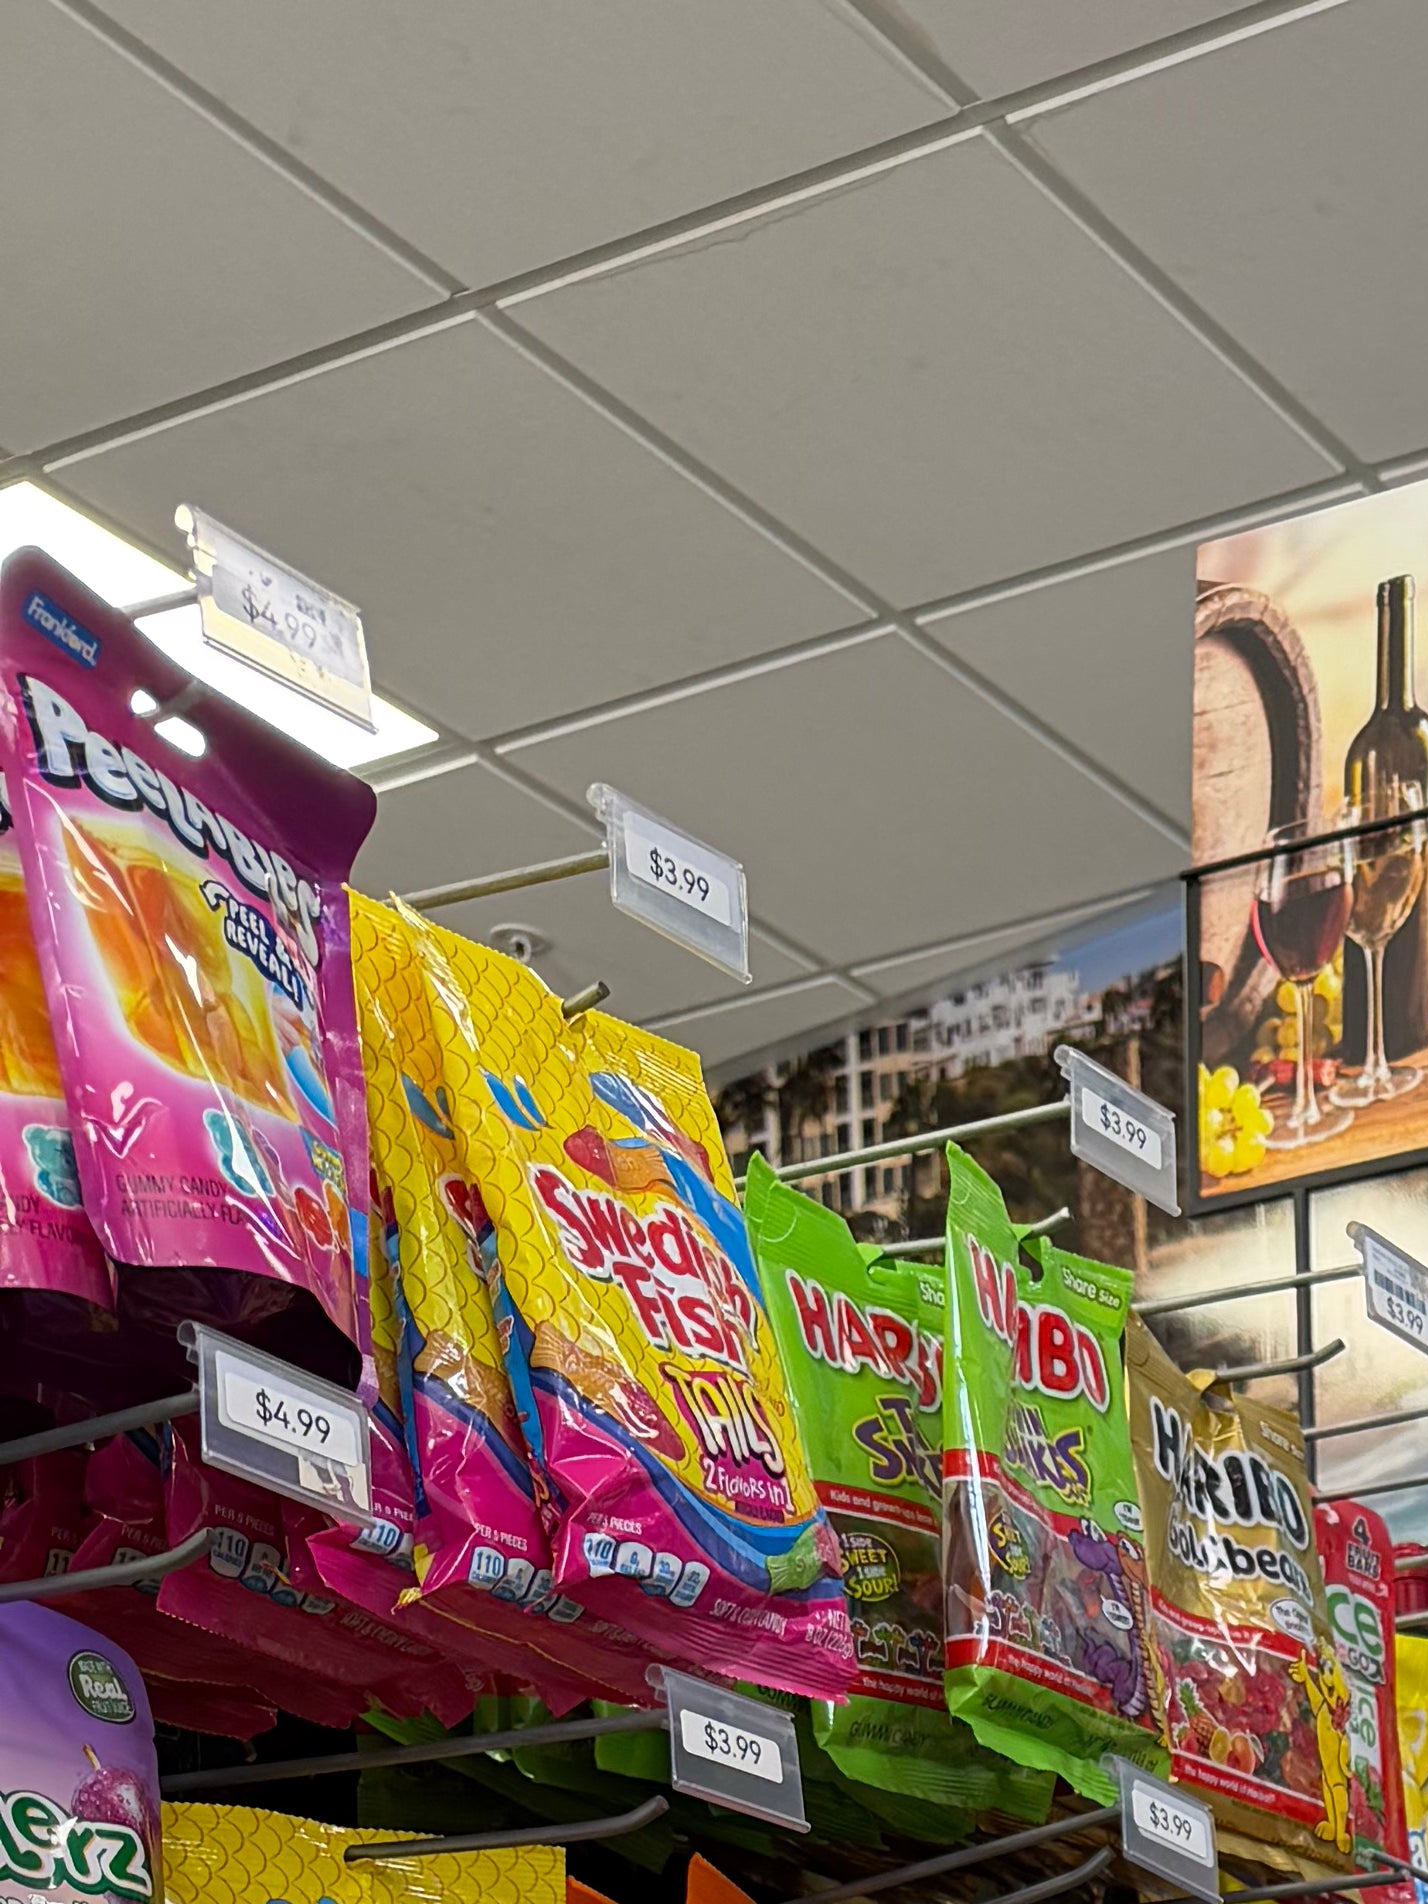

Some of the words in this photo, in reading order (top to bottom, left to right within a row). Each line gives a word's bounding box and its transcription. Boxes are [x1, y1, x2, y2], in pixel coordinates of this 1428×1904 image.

[241, 584, 319, 650] $4.99
[649, 847, 711, 901] $3.99
[228, 901, 273, 942] PEEL
[1100, 1105, 1147, 1150] $3.99
[1063, 1266, 1093, 1296] Share
[615, 1260, 746, 1371] Fish
[1386, 1297, 1424, 1335] $3.99
[255, 1390, 333, 1445] $4.99
[705, 1463, 718, 1488] 2
[1353, 1517, 1369, 1543] 4
[1348, 1557, 1380, 1580] BARS
[80, 1674, 127, 1701] Real
[704, 1723, 762, 1765] $3.99
[1149, 1803, 1192, 1841] $3.99
